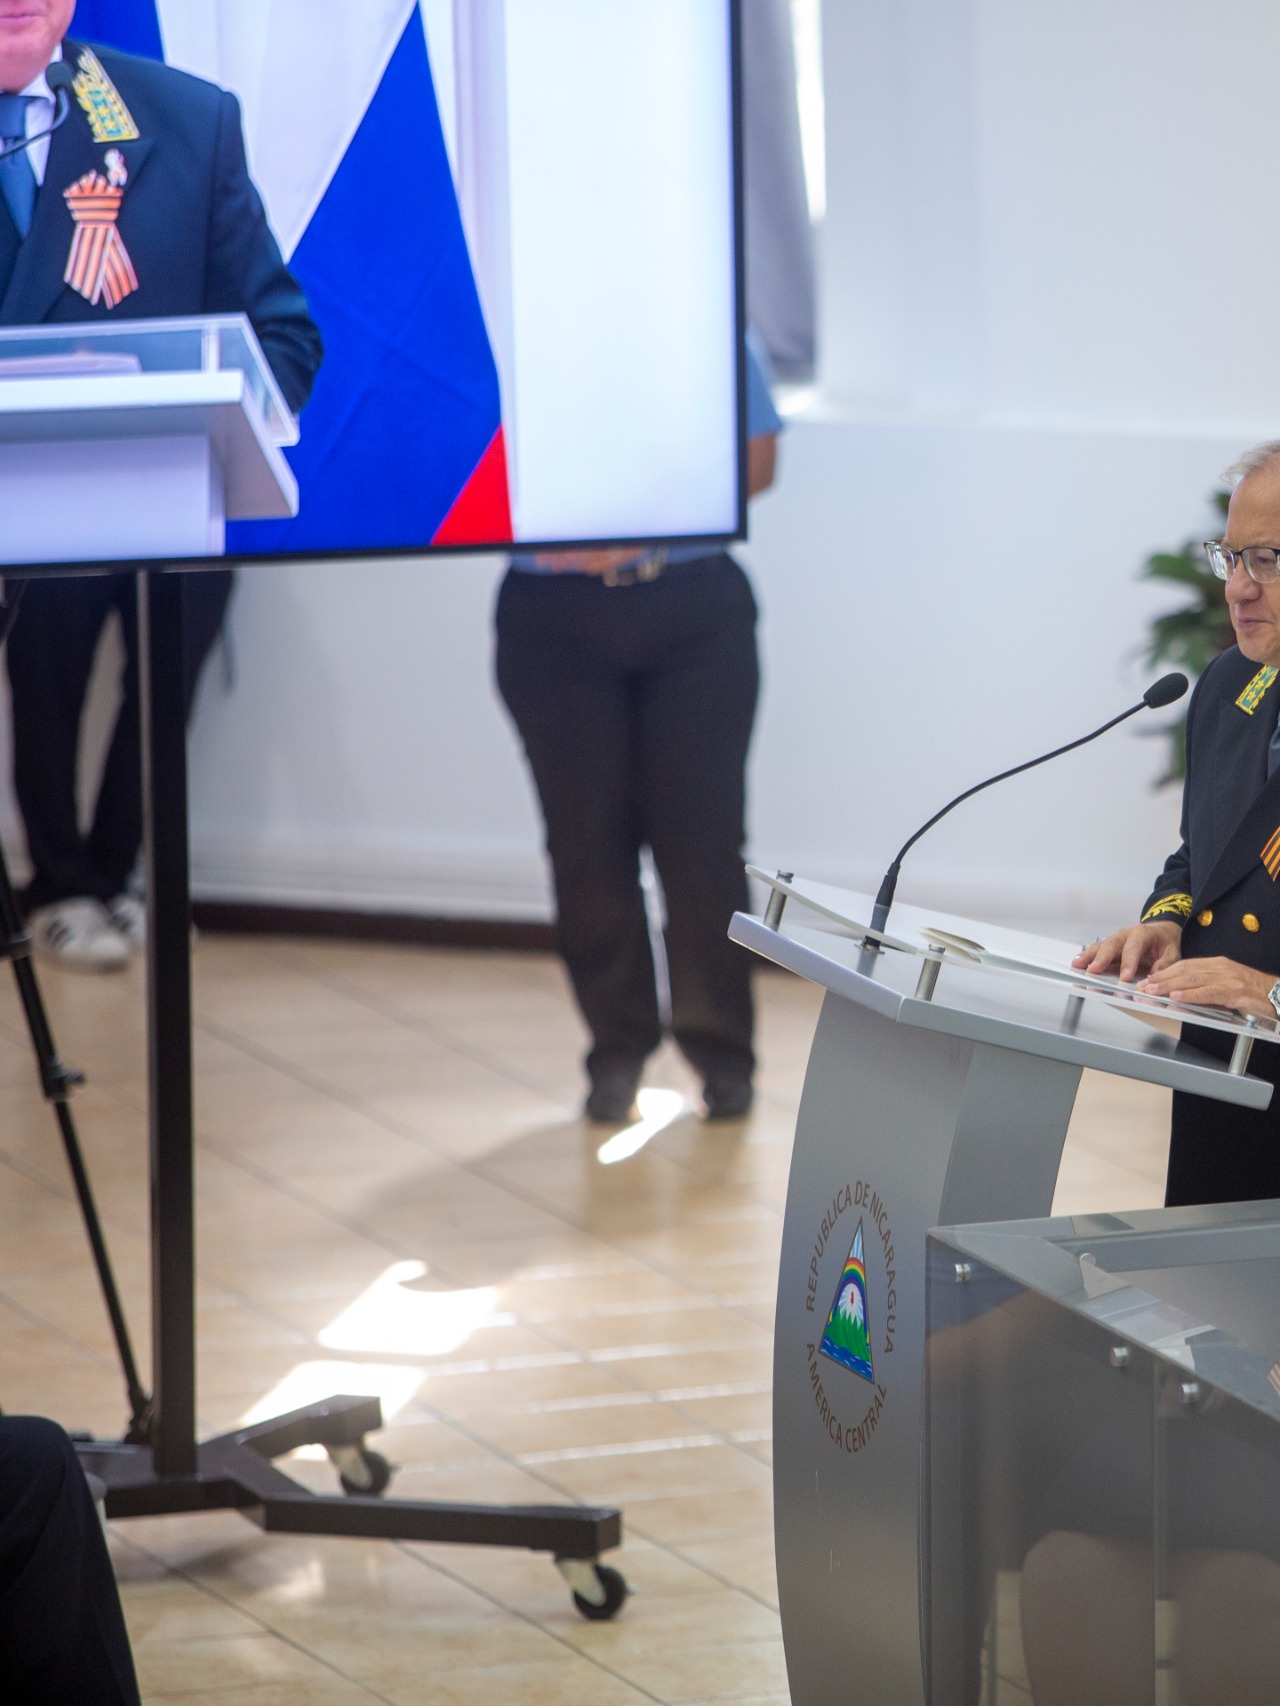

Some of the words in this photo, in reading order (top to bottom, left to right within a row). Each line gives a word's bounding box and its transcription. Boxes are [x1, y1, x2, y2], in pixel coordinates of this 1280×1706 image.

[806, 1184, 852, 1312] REPUBLICA
[855, 1180, 870, 1208] DE
[869, 1191, 897, 1353] NICARAGUA
[807, 1344, 842, 1449] AMERICA
[845, 1383, 887, 1453] CENTRAL
